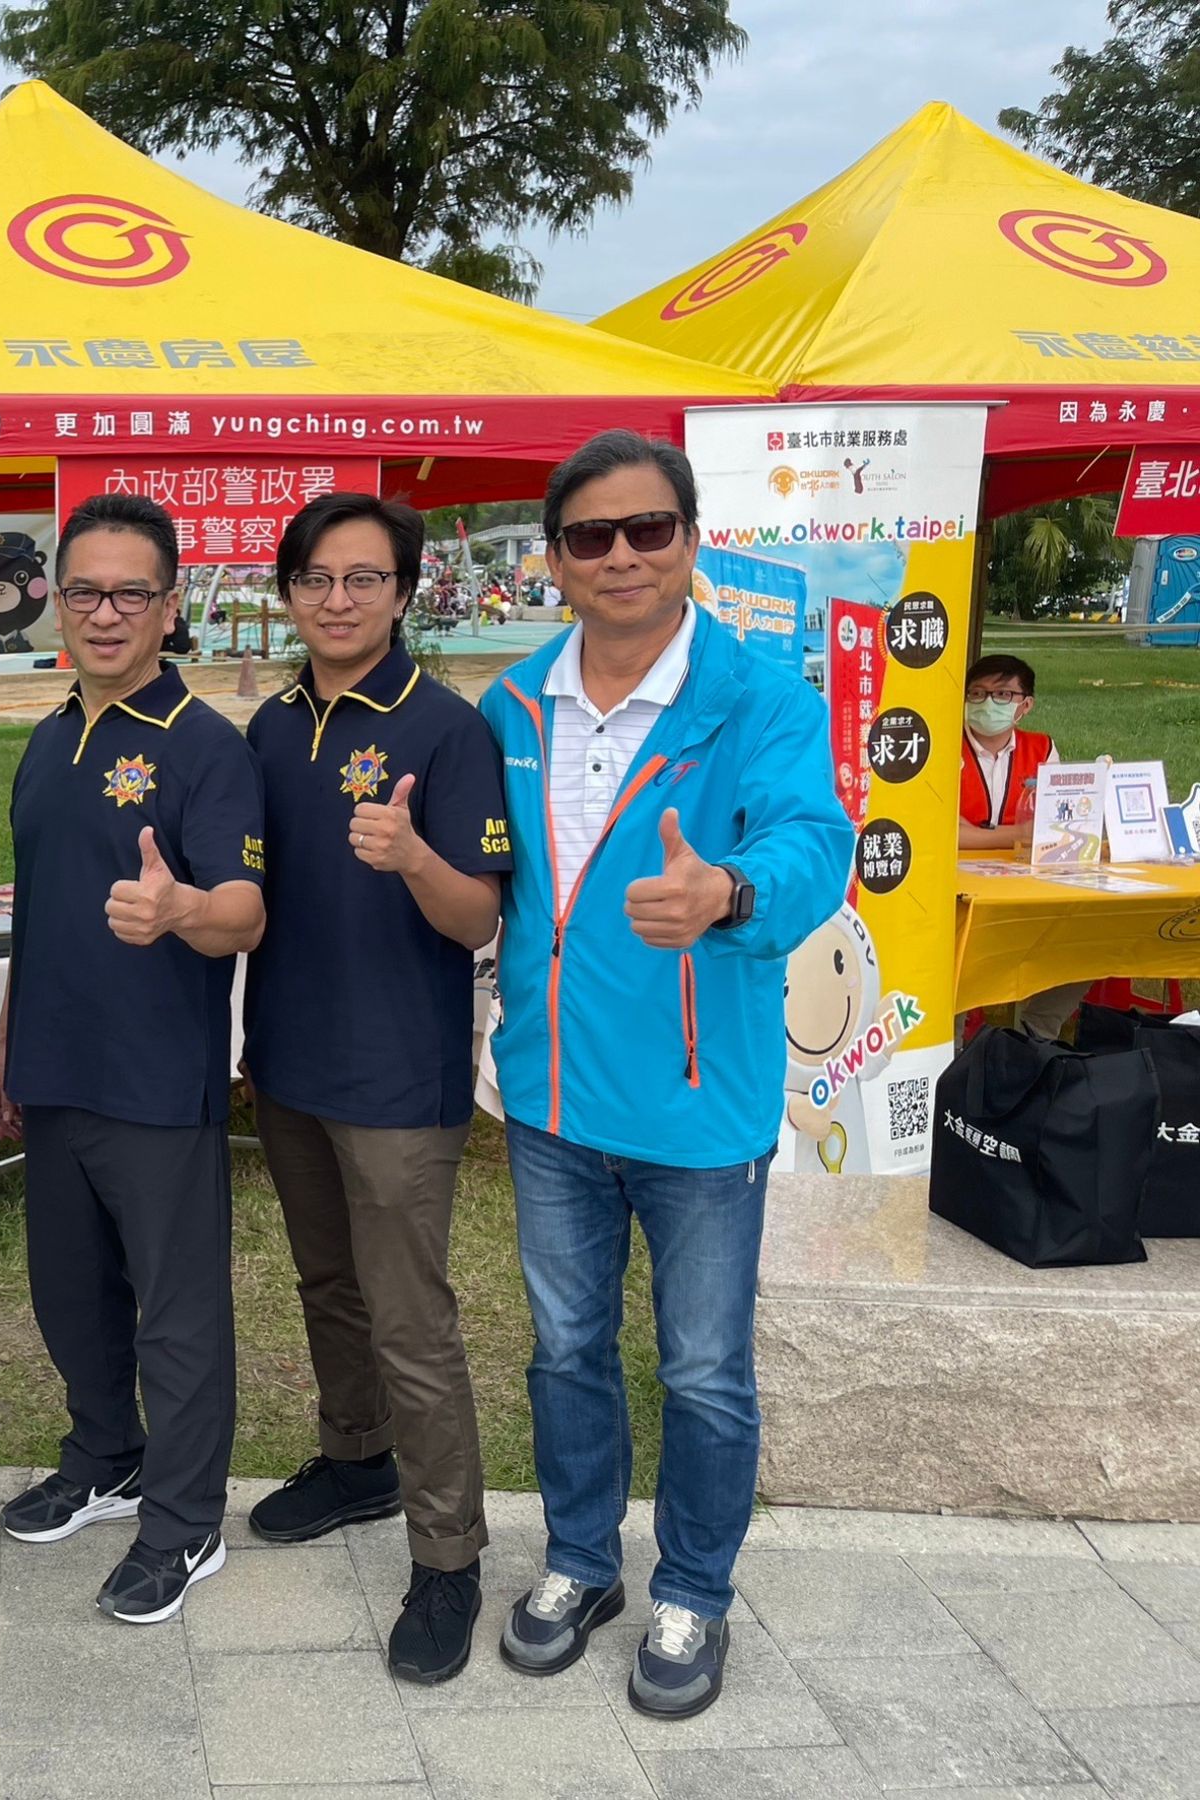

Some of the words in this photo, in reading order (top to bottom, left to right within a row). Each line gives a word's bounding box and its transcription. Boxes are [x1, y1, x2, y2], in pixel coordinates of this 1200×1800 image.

[3, 338, 317, 369] 永慶房屋
[1010, 330, 1200, 361] 永慶慈
[211, 412, 484, 437] yungching.com.tw
[787, 429, 907, 448] 臺北市就業服務處
[105, 466, 337, 506] 內政部警政署
[800, 470, 840, 478] OKWORK
[1132, 460, 1200, 499] 臺北
[709, 515, 965, 547] www.okwork.taipei
[718, 586, 796, 616] OKWORK
[890, 616, 944, 650] 求職
[871, 732, 925, 766] 求才
[485, 818, 507, 835] An
[863, 832, 903, 860] 就業
[863, 858, 903, 879] 博覽會
[812, 995, 922, 1105] okwork
[1156, 1121, 1200, 1143] 大金
